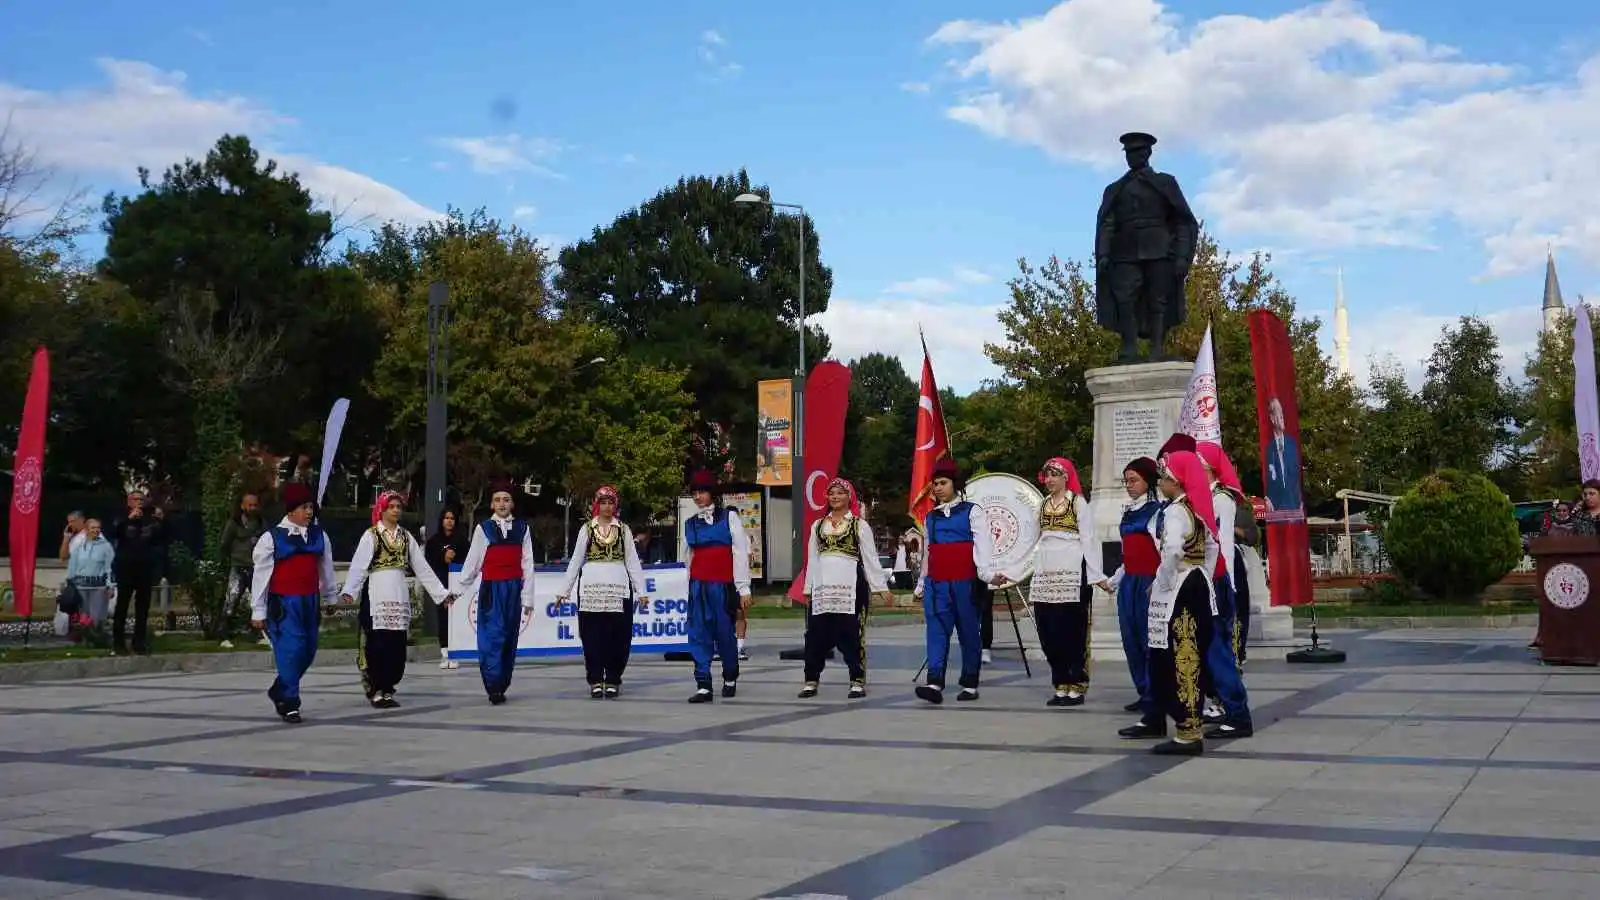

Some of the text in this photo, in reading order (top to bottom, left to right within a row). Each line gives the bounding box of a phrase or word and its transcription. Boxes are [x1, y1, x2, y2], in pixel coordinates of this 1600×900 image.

[654, 599, 688, 614] SPO
[558, 617, 688, 639] İL RLÜĞÜ
